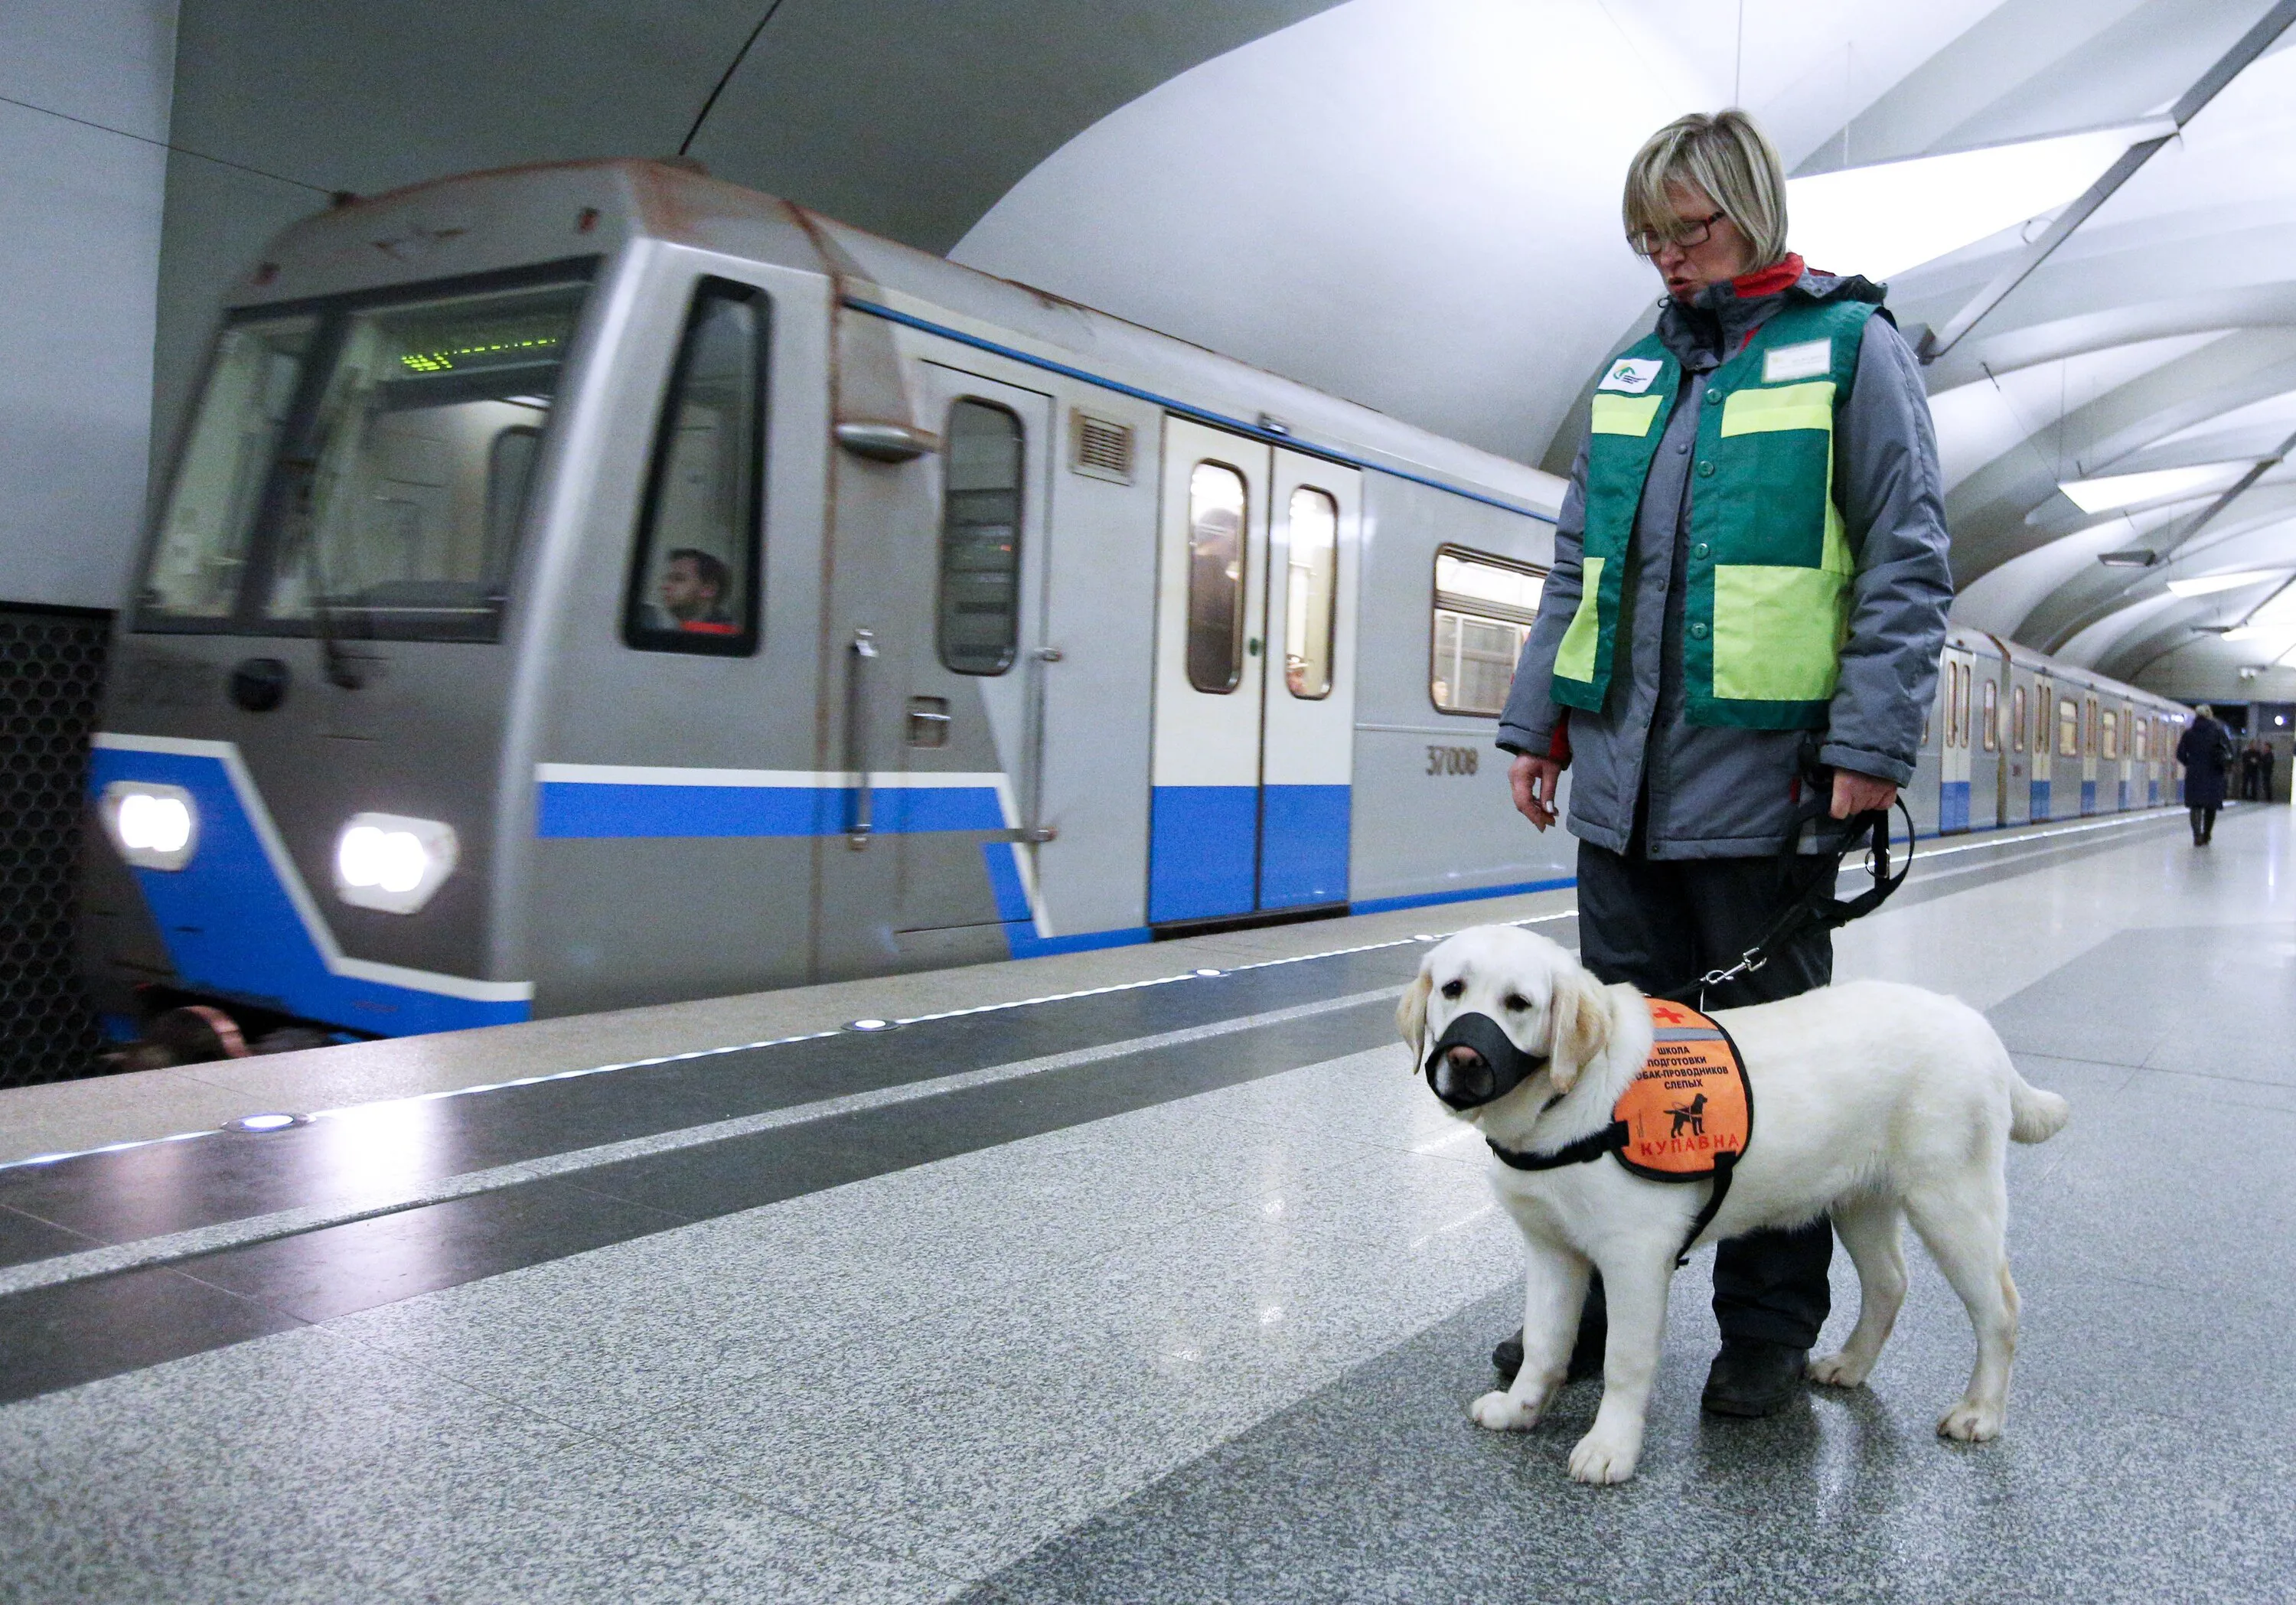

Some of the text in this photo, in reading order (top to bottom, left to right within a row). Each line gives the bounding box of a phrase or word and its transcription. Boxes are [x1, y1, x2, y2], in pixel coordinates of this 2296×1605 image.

[1657, 1046, 1691, 1055] ШКОЛА
[1647, 1056, 1707, 1068] ПОДГОТОВКИ
[1636, 1066, 1729, 1081] ОБАК-ПРОВОДНИКОВ
[1665, 1078, 1704, 1090] СЛЕПЫХ
[1640, 1134, 1740, 1156] КУПАВНА
